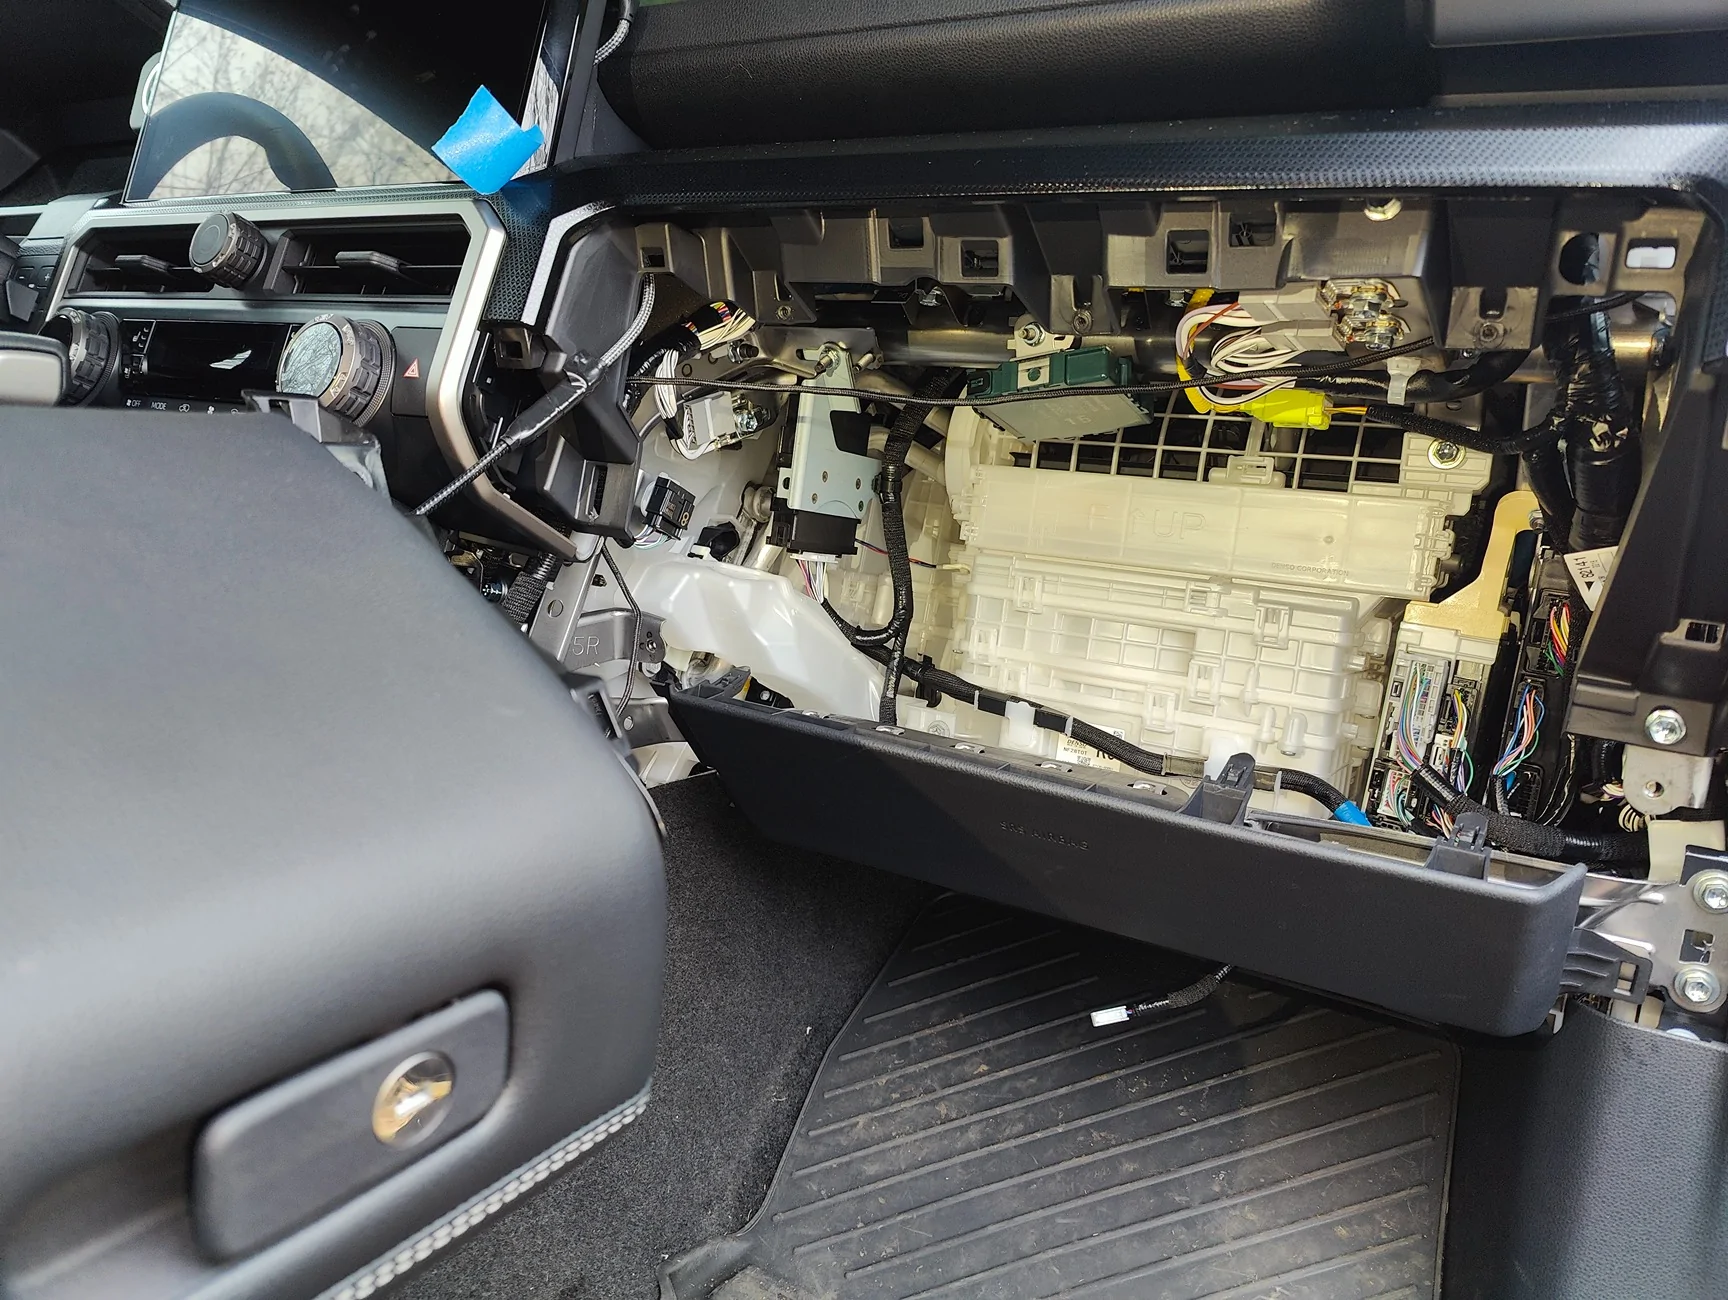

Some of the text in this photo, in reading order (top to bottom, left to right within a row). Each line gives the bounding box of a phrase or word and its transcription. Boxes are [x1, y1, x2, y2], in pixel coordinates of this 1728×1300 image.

[131, 399, 167, 410] OFF MODE
[681, 511, 690, 526] 8
[1153, 508, 1206, 539] UP
[1297, 564, 1349, 576] CORPORATION
[1574, 556, 1594, 578] 82141
[572, 635, 600, 656] 5R
